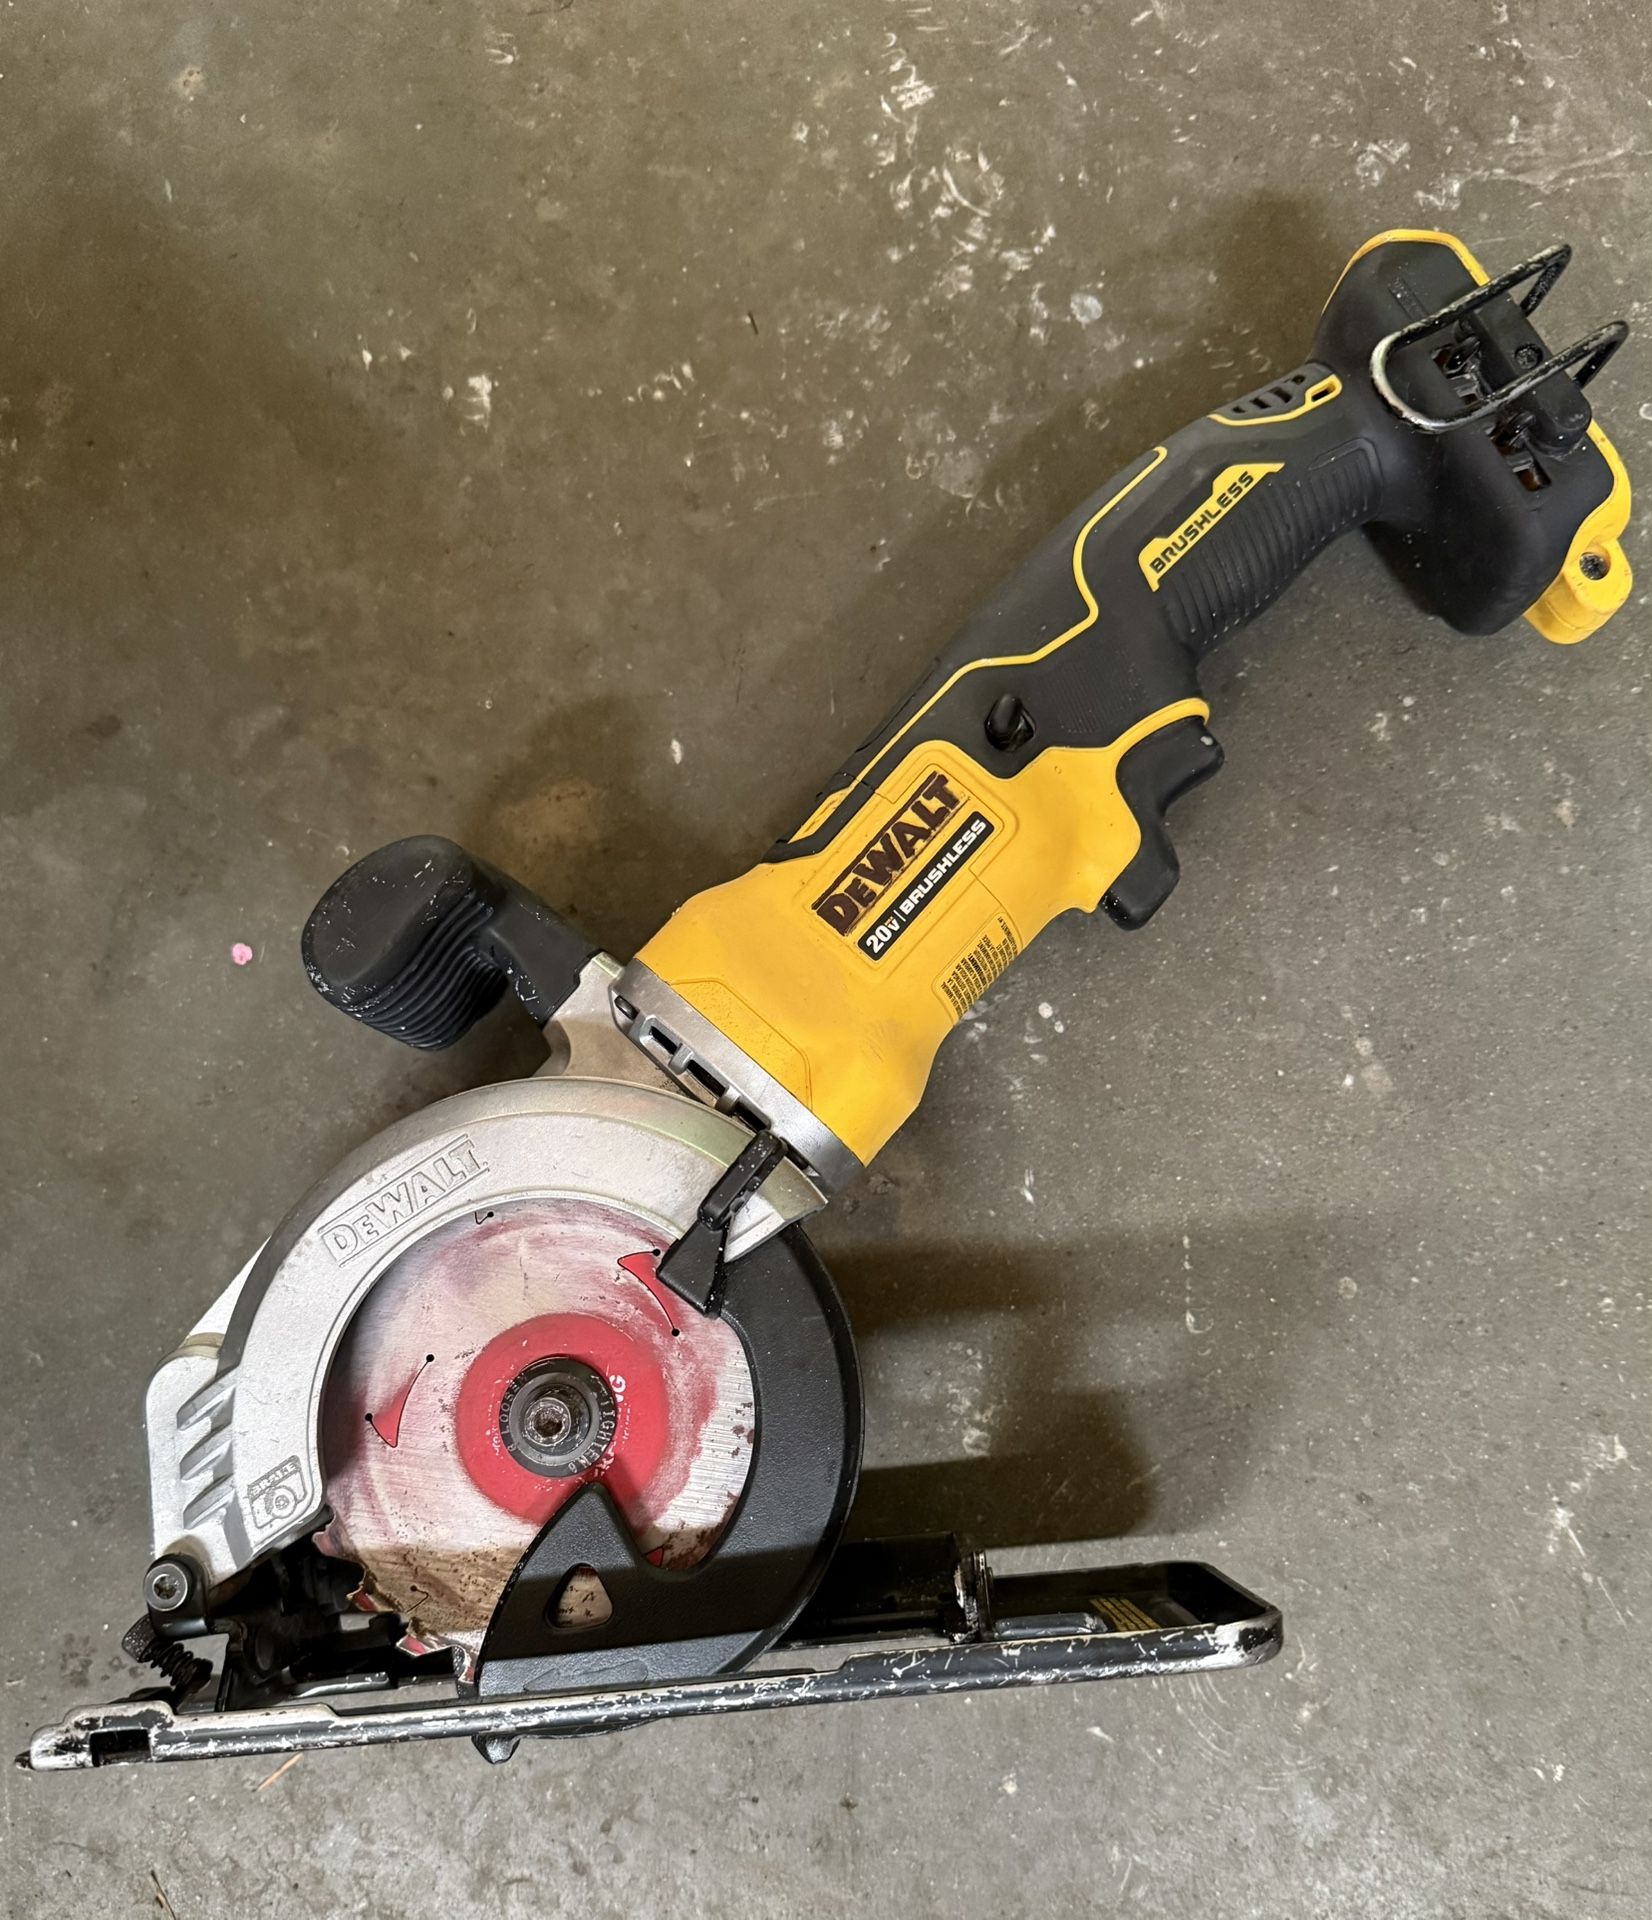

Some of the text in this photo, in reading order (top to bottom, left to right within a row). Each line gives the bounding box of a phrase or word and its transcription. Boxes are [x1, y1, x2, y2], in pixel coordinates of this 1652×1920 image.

[1150, 471, 1255, 575] BRUSHLESS
[900, 819, 987, 916] BRUSHLESS
[580, 1396, 616, 1468] TIGHTEN
[250, 1462, 297, 1497] BRAKE
